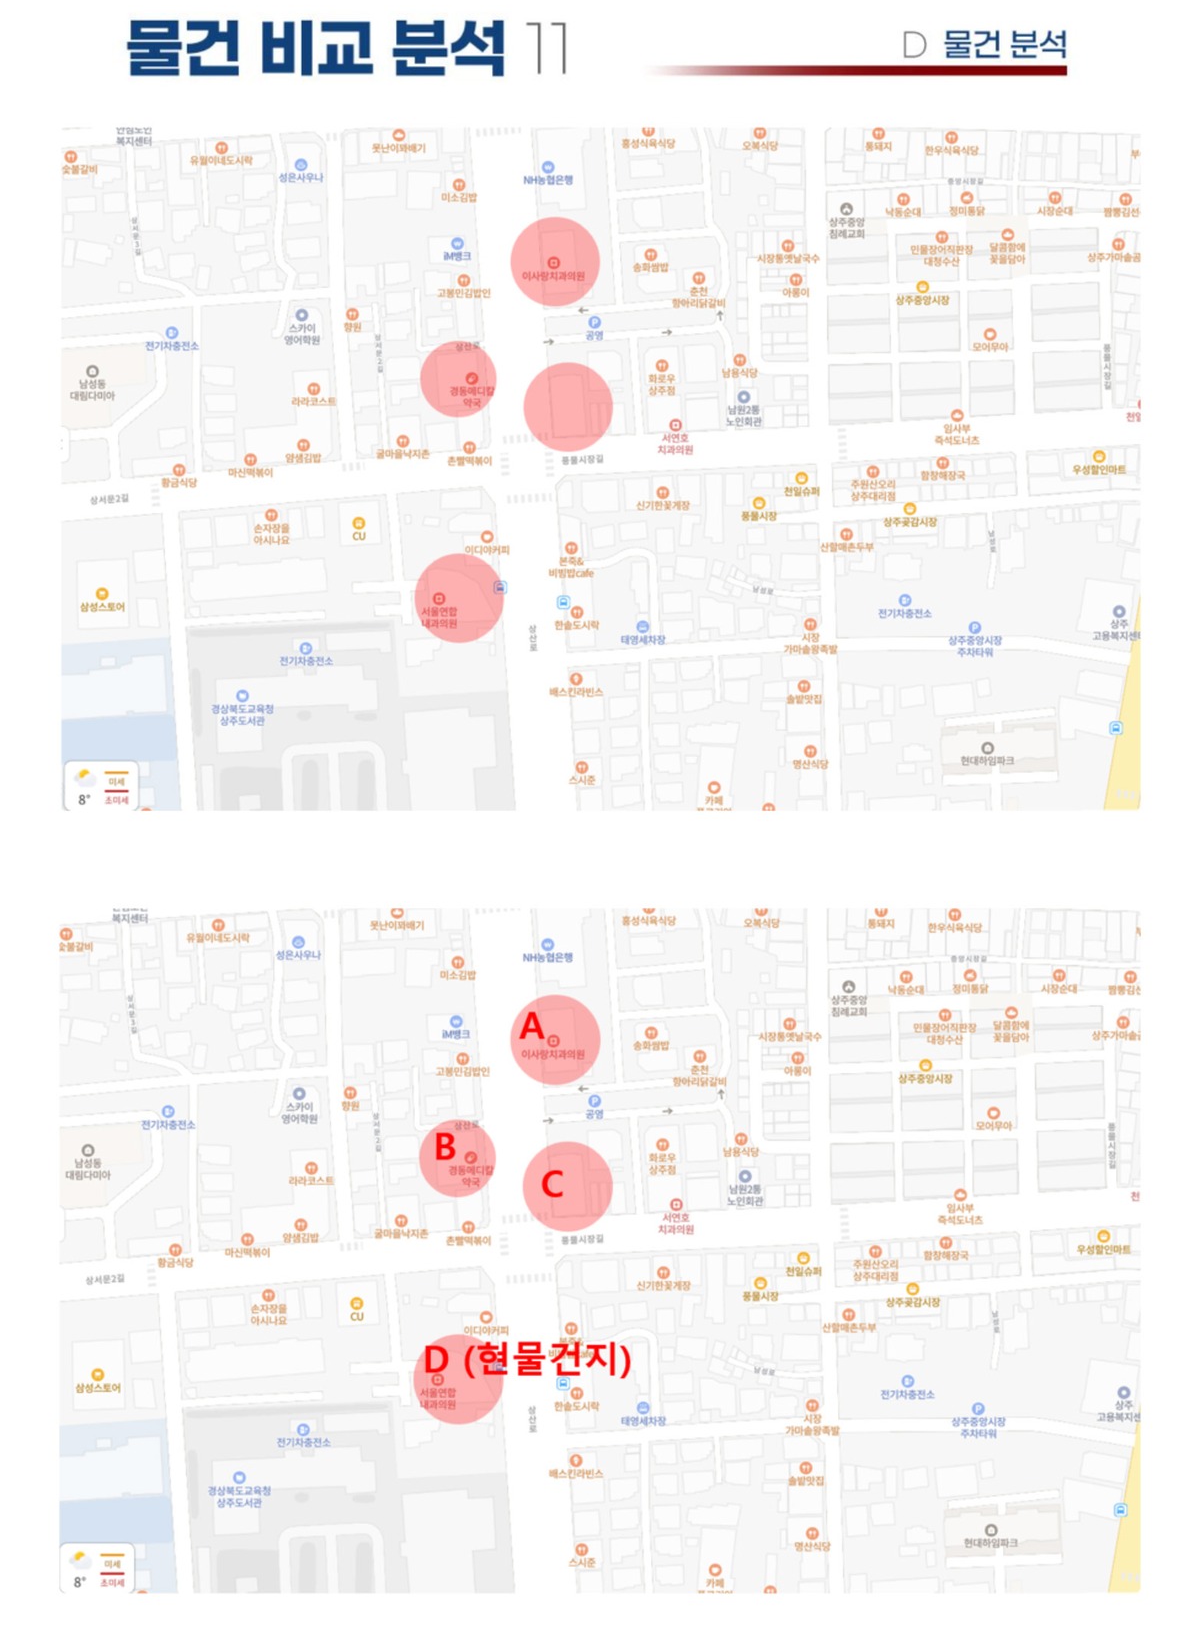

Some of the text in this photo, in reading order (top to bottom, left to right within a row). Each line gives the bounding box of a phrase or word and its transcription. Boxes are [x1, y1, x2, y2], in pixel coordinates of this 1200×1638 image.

[127, 20, 566, 77] 물건 비교 분석 11
[904, 30, 1066, 58] D 물건 분석
[116, 135, 153, 147] 복지센터
[621, 138, 676, 149] 홍성식육식당
[742, 140, 779, 152] 오복식당
[865, 140, 893, 152] 통돼지
[371, 142, 426, 154] 못난이꽈배기
[925, 145, 979, 156] 한우식육식당
[190, 155, 253, 167] 유월이네도시락
[279, 172, 324, 184] 성은사우나
[523, 174, 574, 186] NH농협은행
[441, 192, 478, 203] 미소김밥
[885, 206, 922, 218] 낙동순대
[949, 205, 985, 216] 정미통닭
[1037, 205, 1073, 217] 시장순대
[829, 216, 865, 229] 상주중앙
[829, 228, 865, 240] 침례교회
[910, 244, 974, 256] 민물장어직판장
[989, 242, 1027, 253] 달콤함에
[443, 251, 472, 262] iM뱅크
[757, 252, 820, 265] 시장통옛날국수
[923, 256, 961, 268] 대청수산
[989, 253, 1027, 266] 꽃을담아
[632, 262, 669, 274] 송화쌈밥
[522, 270, 586, 282] 이사랑치과의원
[437, 288, 491, 299] 고봉민김밥인
[689, 286, 709, 298] 춘천
[782, 287, 810, 298] 아롱이
[671, 297, 726, 309] 항아리닭갈비
[895, 295, 950, 306] 상주중앙시장
[288, 323, 316, 334] 스카이
[343, 321, 362, 333] 향원
[284, 335, 321, 346] 영어학원
[585, 330, 604, 342] 공영
[145, 341, 199, 352] 전기차충전소
[721, 367, 758, 379] 남용식당
[78, 379, 107, 390] 남성동
[70, 390, 116, 402] 대림다미아
[450, 385, 495, 397] 경동메디칼
[291, 395, 337, 407] 라라코스트
[463, 397, 481, 409] 약국
[943, 423, 971, 435] 임사부
[662, 432, 689, 444] 서연호
[934, 435, 980, 447] 즉석도너츠
[657, 444, 694, 456] 치과의원
[285, 452, 322, 464] 얌샘김밥
[447, 455, 492, 467] 촌빨떡볶이
[561, 454, 604, 466] 풍물시장길
[1072, 464, 1127, 476] 우성할인마트
[161, 477, 198, 488] 황금식당
[784, 486, 820, 497] 천일슈퍼
[90, 493, 130, 506] 상서문2길
[741, 510, 777, 522] 풍물시장
[883, 516, 938, 528] 상주곶감시장
[352, 531, 366, 542] CU
[464, 544, 510, 556] 이디야커피
[558, 556, 584, 568] 본죽&
[548, 567, 595, 579] 비빔밥cafe
[80, 601, 126, 613] 삼성스토어
[421, 606, 458, 618] 서울연합
[421, 618, 458, 630] 내과의원
[621, 634, 666, 646] 태영세차장
[957, 647, 994, 658] 주차타워
[549, 686, 604, 698] 배스킨라빈스
[220, 715, 266, 727] 상주도서관
[960, 755, 1015, 767] 현대하임파크
[108, 777, 125, 786] 미세
[78, 793, 92, 806] 8°
[104, 795, 129, 806] 초미세
[523, 952, 574, 964] NH농협은행
[898, 1073, 953, 1084] 상주중앙시장
[728, 1183, 761, 1195] 남원2통
[727, 1195, 764, 1207] 노인회관
[374, 1228, 429, 1240] 굴마을낙지촌
[250, 1303, 287, 1314] 손자장을
[250, 1314, 287, 1326] 아시나요
[822, 1321, 876, 1333] 산할매촌두부
[554, 1400, 600, 1412] 한솔도시락
[786, 1425, 840, 1437] 가마솥왕족발
[788, 1476, 825, 1487] 솔밭맛집
[208, 1485, 271, 1497] 경상북도교육청
[795, 1540, 831, 1552] 명산식당
[568, 1556, 596, 1568] 스시준
